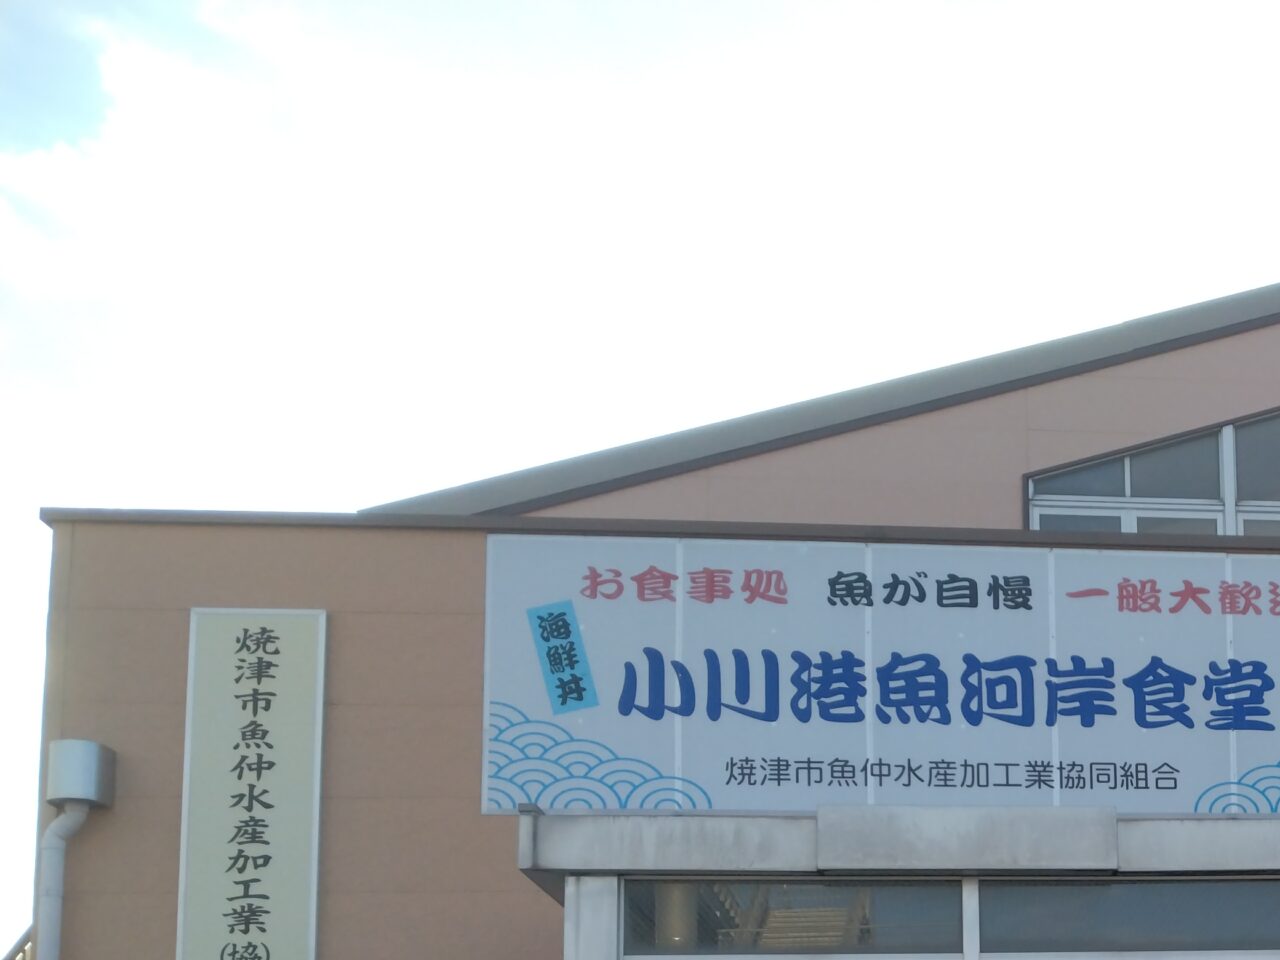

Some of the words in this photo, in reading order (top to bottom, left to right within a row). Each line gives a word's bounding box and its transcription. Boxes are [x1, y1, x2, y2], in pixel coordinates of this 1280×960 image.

[581, 565, 789, 604] お食事処
[826, 569, 1034, 612] 魚が自慢
[535, 611, 588, 706] 海鮮丼
[616, 645, 1278, 733] 小川港魚河岸食堂
[725, 755, 1181, 792] 焼津市魚仲水産加工業協同組合
